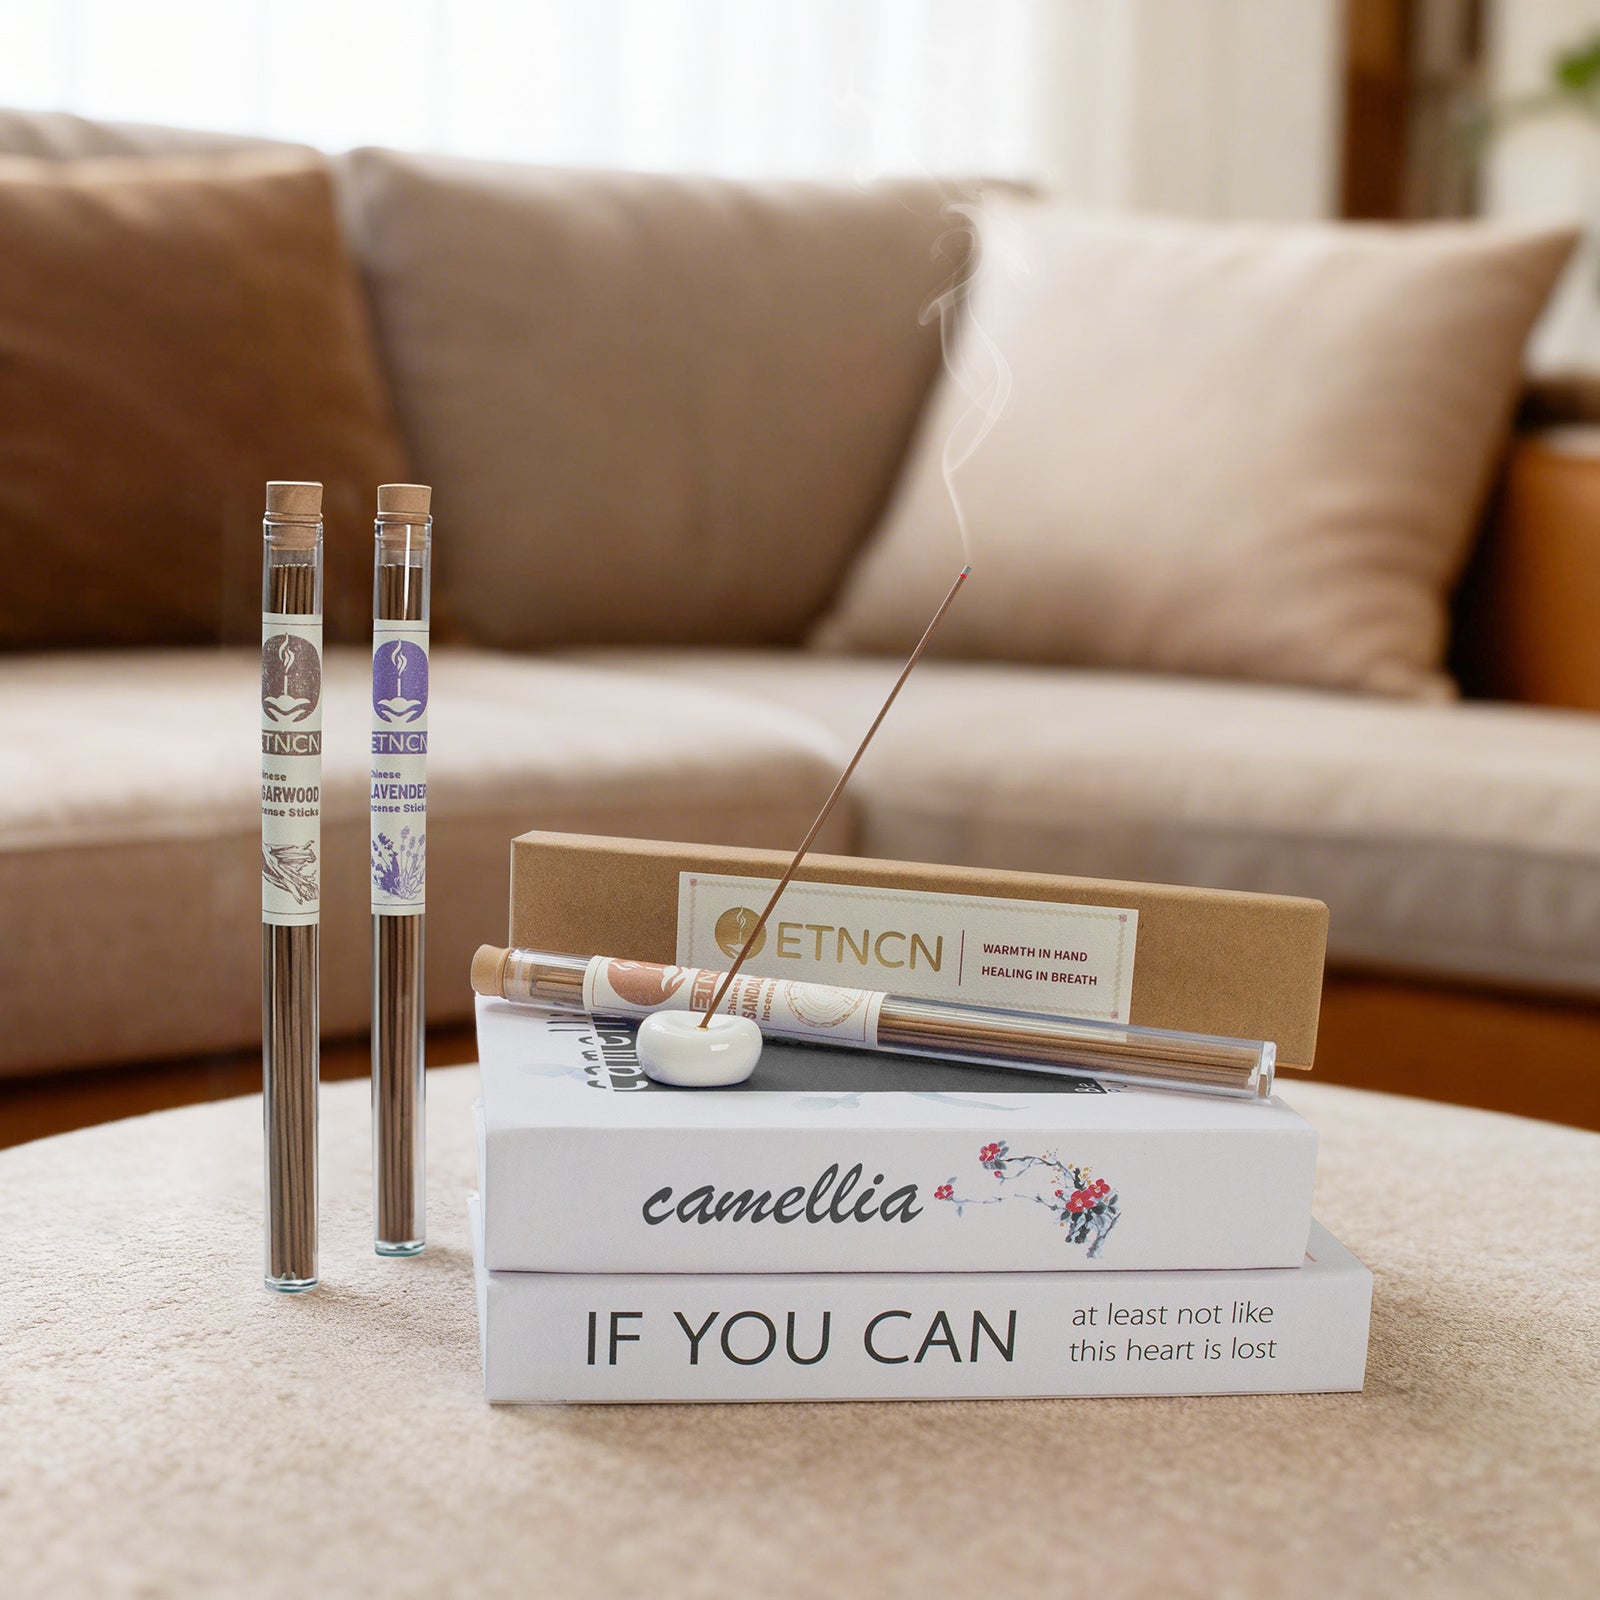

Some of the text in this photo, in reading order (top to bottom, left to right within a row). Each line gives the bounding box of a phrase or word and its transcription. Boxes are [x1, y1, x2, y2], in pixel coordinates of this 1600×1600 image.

[262, 732, 320, 753] TNCN
[262, 785, 320, 803] GARWOOD
[288, 807, 319, 818] Sticks
[776, 921, 944, 973] ETNCN
[983, 943, 1088, 962] WARMTH IN HAND
[981, 965, 1098, 986] HEALING IN BREATH
[642, 1162, 924, 1226] camellia
[1072, 1300, 1274, 1327] at least not like
[587, 1309, 1017, 1366] IF YOU CAN
[1069, 1336, 1278, 1363] this heart is lost
